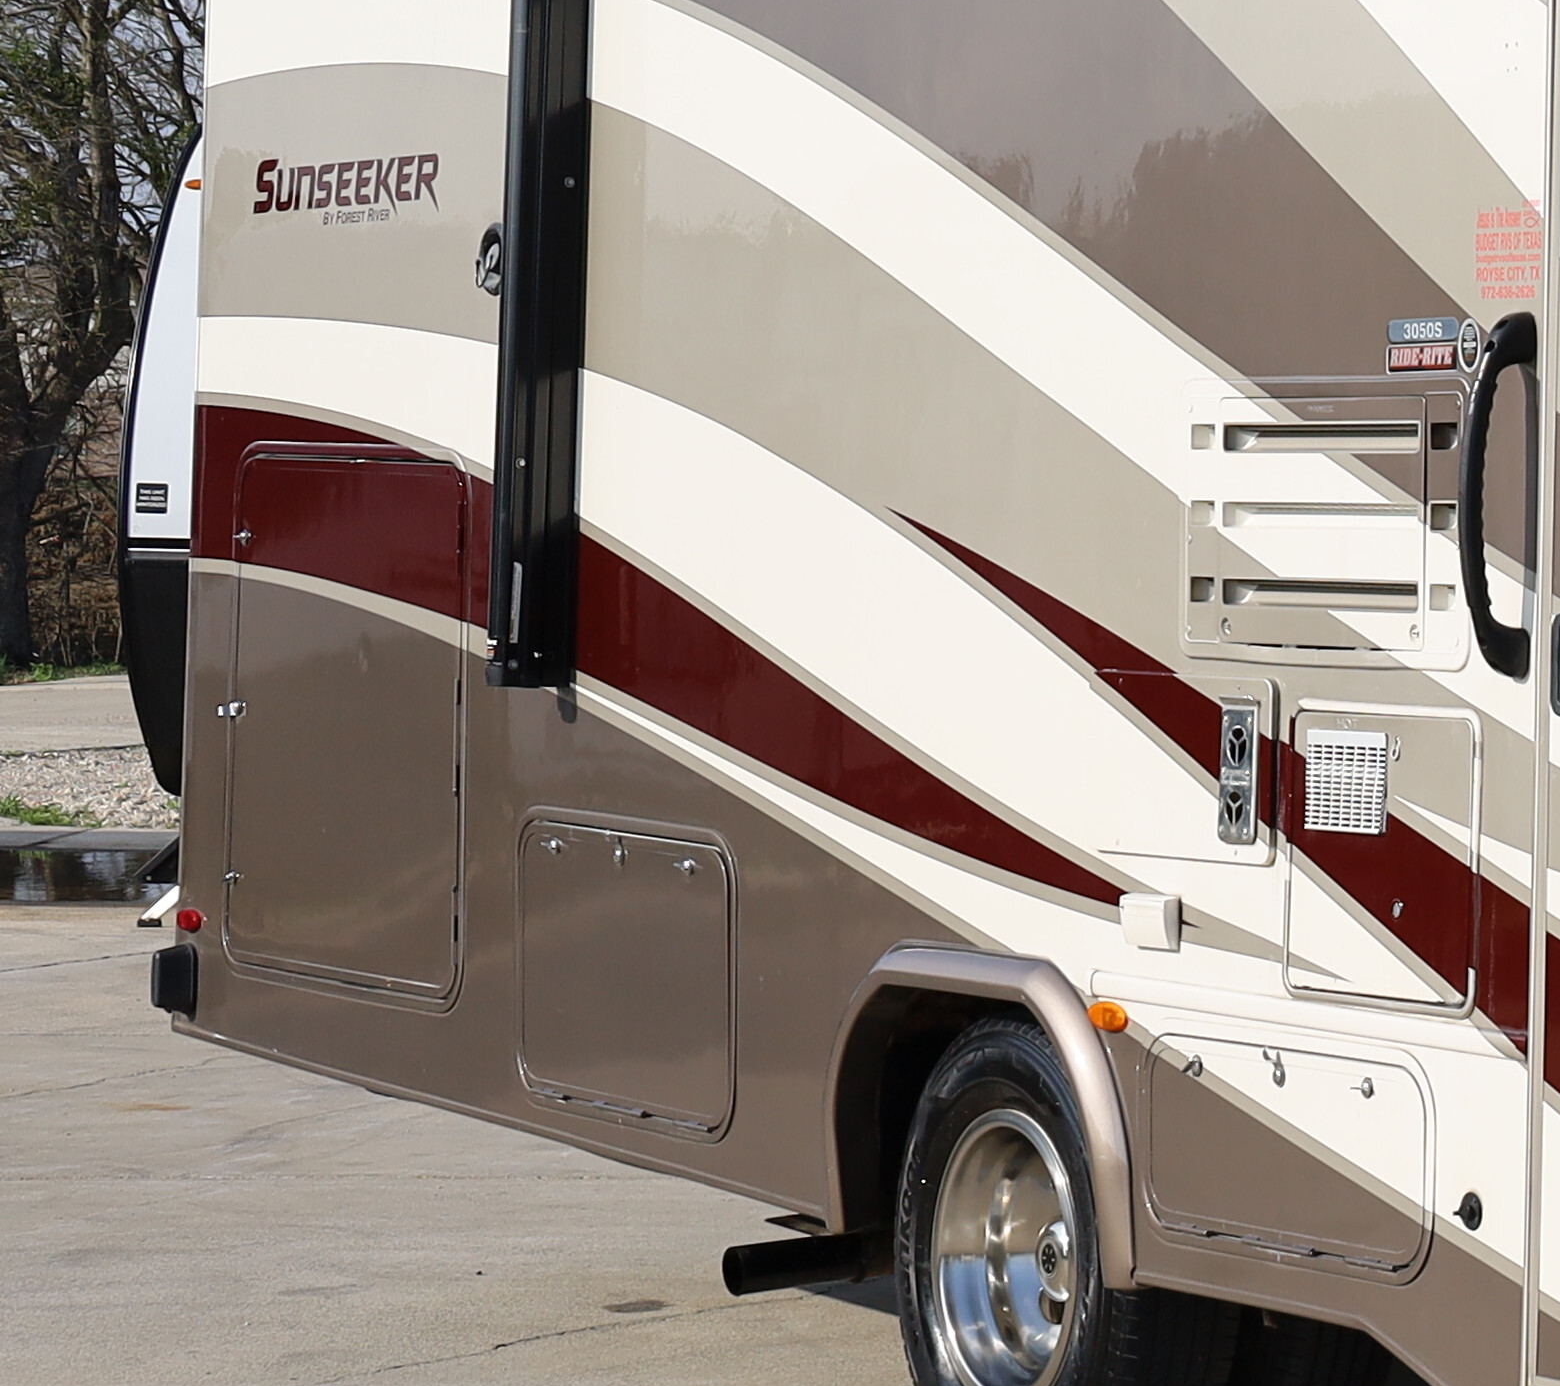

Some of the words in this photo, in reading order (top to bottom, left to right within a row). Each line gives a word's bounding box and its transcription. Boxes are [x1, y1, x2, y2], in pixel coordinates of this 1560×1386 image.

[1476, 267, 1505, 282] ROYSE
[1529, 265, 1541, 281] TX
[1402, 321, 1443, 340] 3050S
